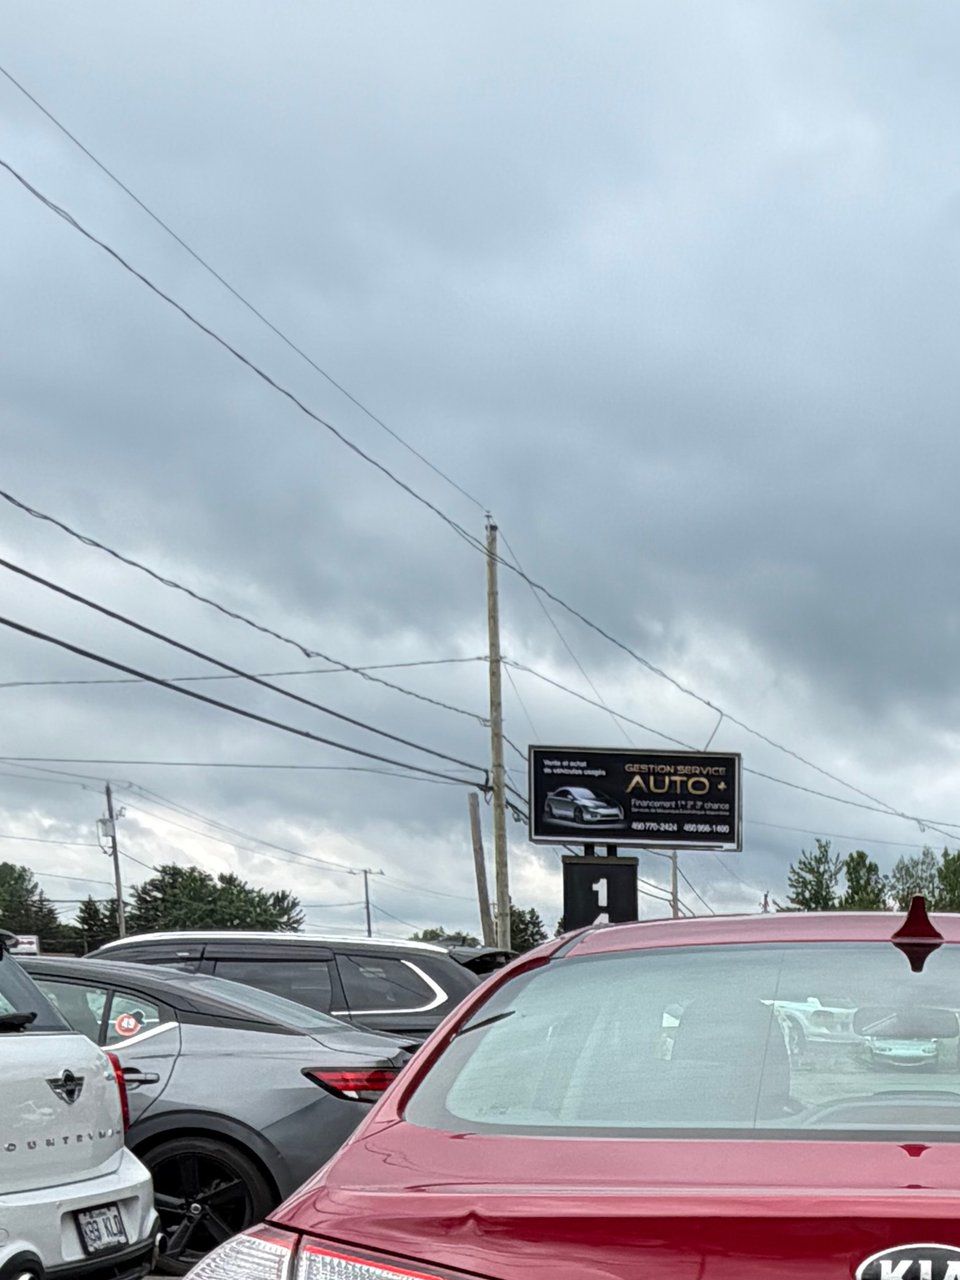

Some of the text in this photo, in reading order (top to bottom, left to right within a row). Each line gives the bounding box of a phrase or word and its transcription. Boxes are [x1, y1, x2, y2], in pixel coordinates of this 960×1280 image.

[624, 763, 727, 776] GESTION SERVICE
[625, 774, 710, 795] AUTO
[630, 798, 676, 809] Financement
[591, 877, 608, 907] 1
